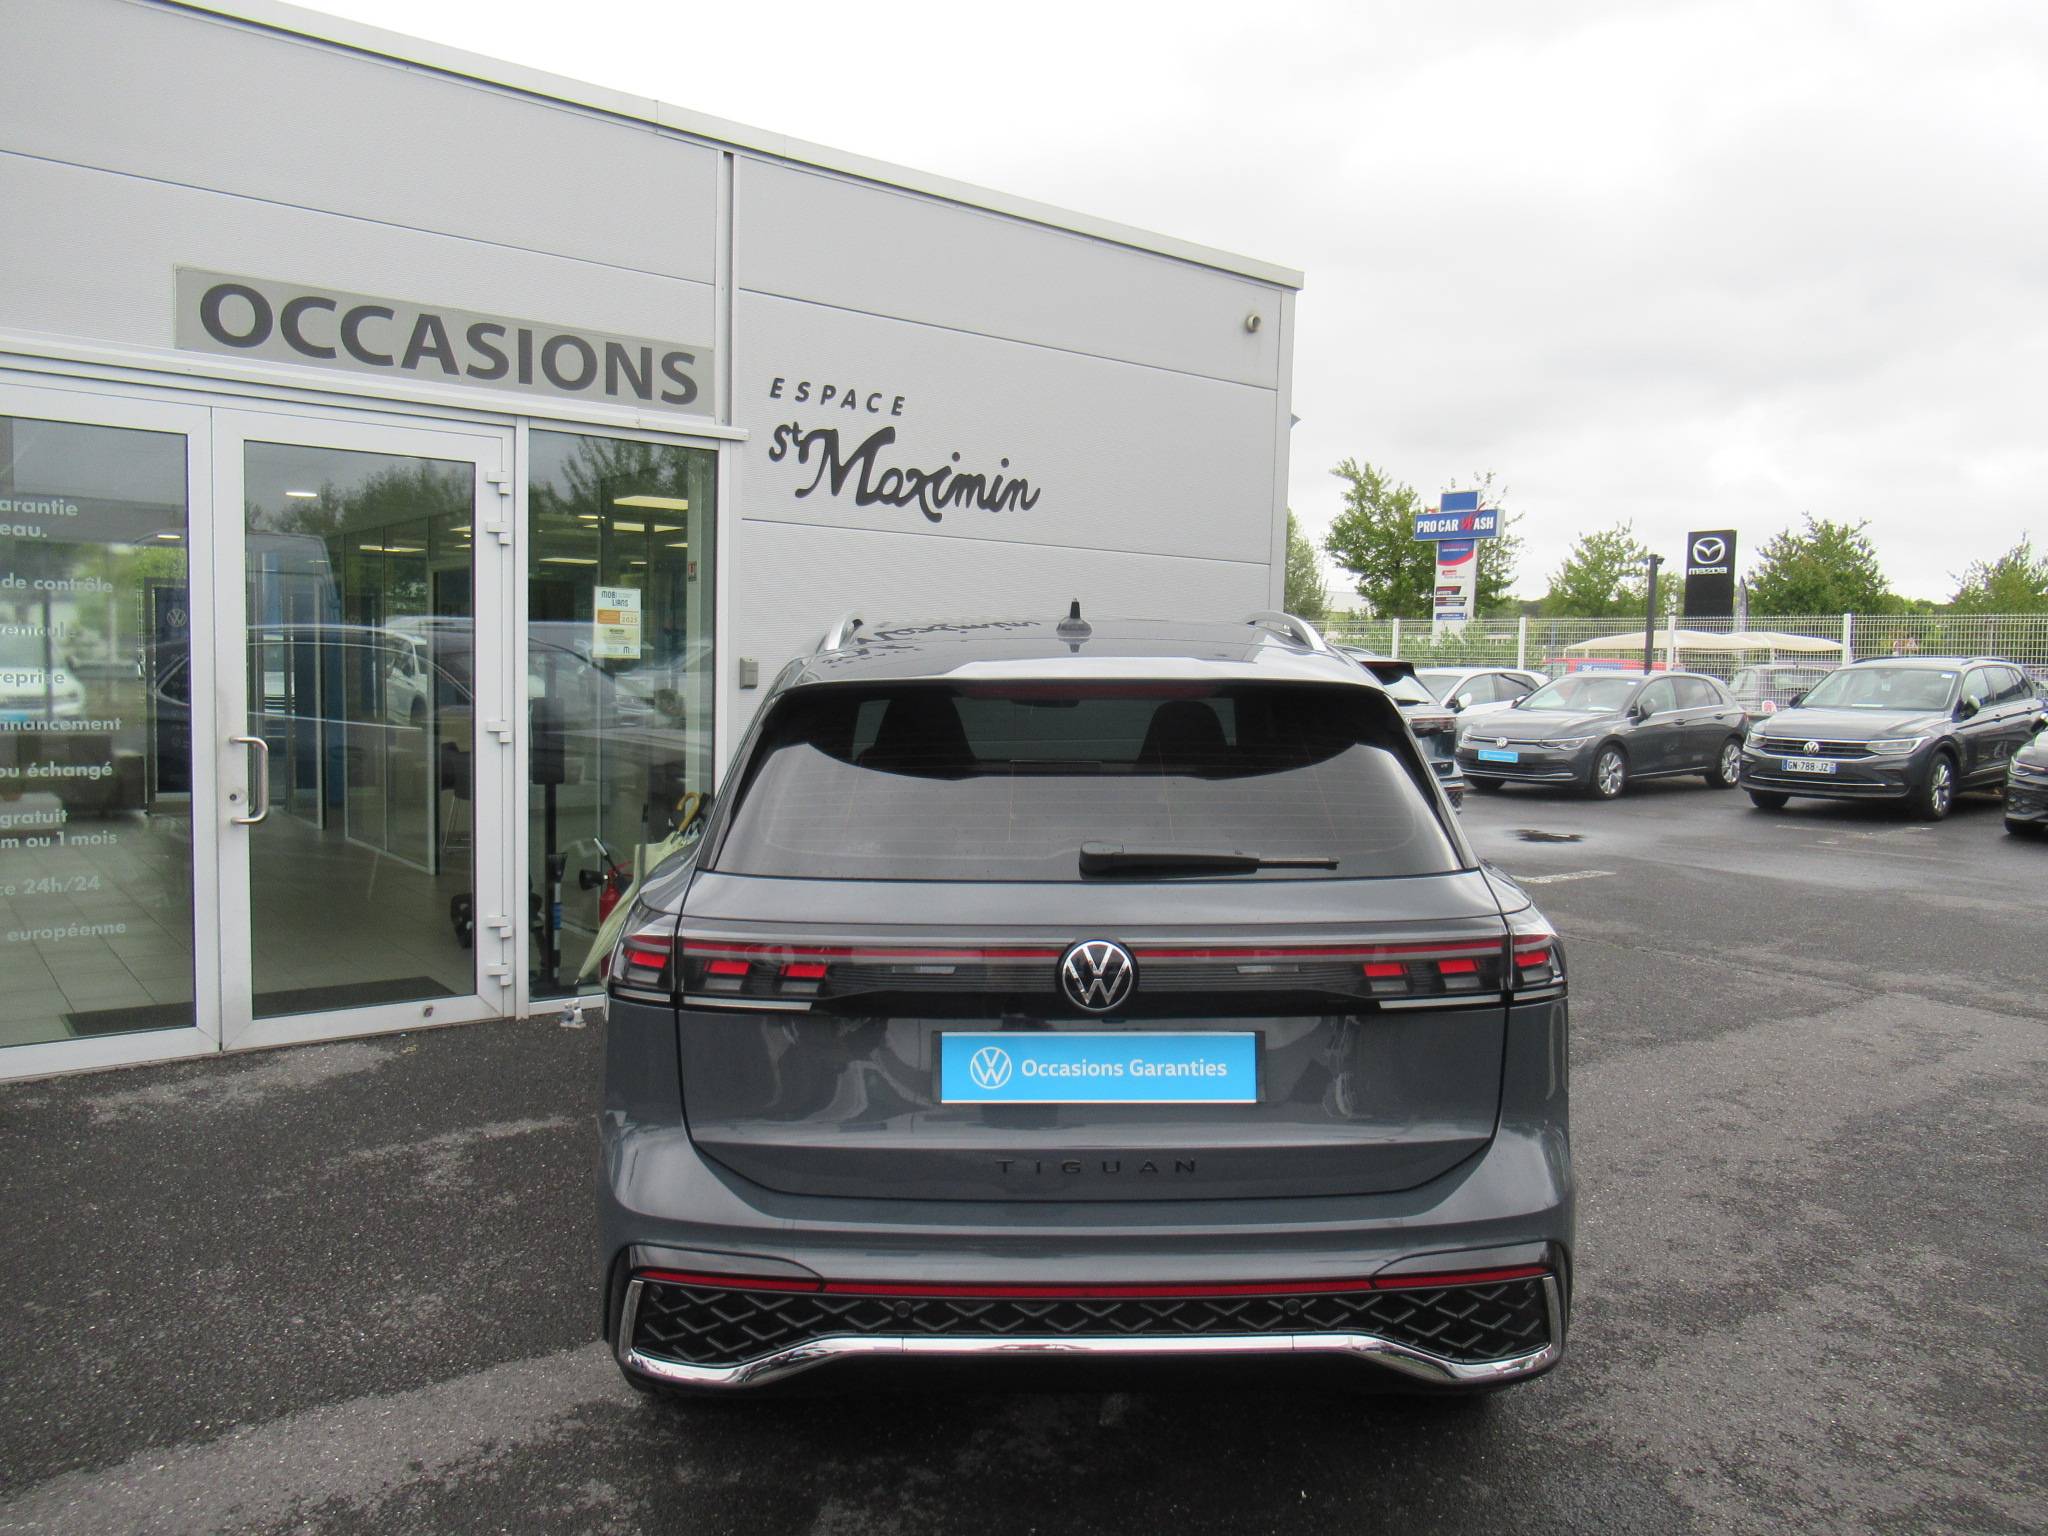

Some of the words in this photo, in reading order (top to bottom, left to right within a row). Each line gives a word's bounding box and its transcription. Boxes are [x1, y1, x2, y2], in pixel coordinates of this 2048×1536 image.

[200, 283, 698, 405] OCCASIONS
[769, 377, 906, 416] ESPACE
[795, 425, 1041, 523] Maximin
[0, 498, 79, 517] arantie
[0, 523, 48, 538] eau.
[1416, 520, 1437, 533] PRO
[1438, 519, 1459, 532] CAR
[1, 572, 27, 589] de
[34, 575, 113, 593] contrôle
[0, 716, 122, 731] inancement
[27, 761, 113, 780] échangé
[0, 808, 68, 828] gratuit
[26, 837, 51, 848] ou
[71, 830, 118, 846] mois
[23, 875, 102, 895] 24h/24
[8, 921, 127, 942] européenne
[1021, 1059, 1123, 1078] Occasions
[1129, 1059, 1228, 1078] Garanties
[996, 1158, 1199, 1175] TIGUAN
